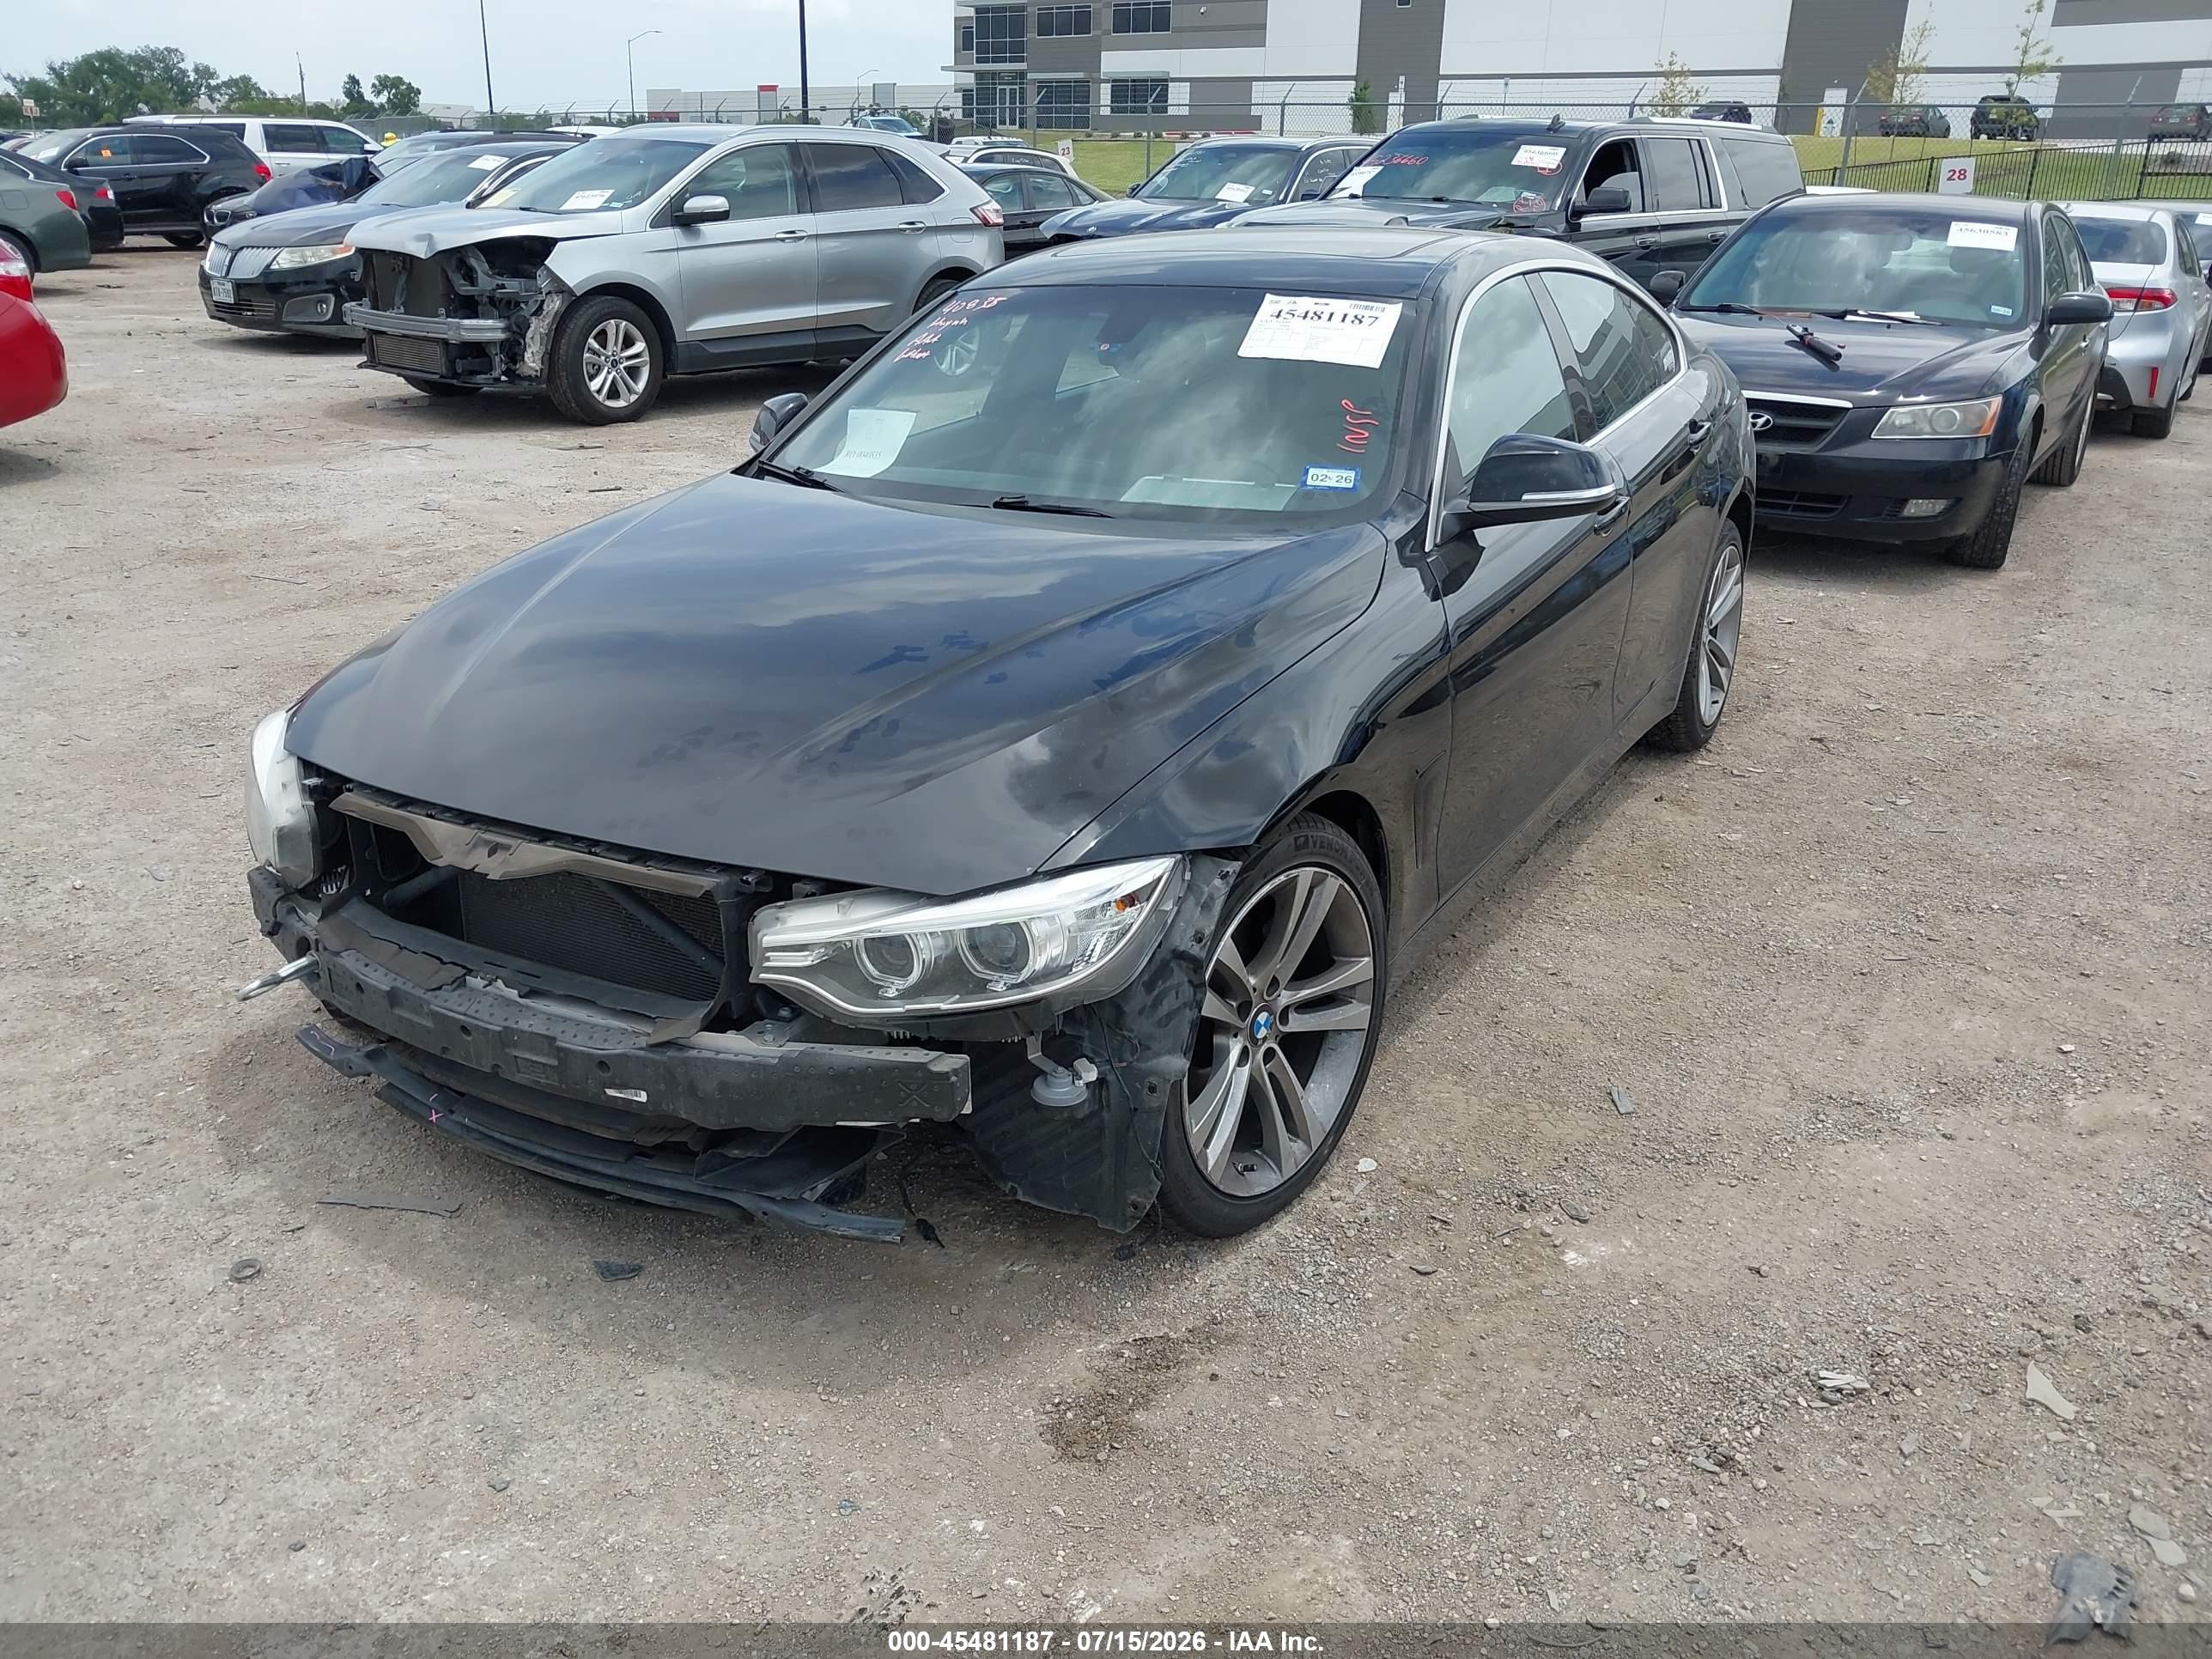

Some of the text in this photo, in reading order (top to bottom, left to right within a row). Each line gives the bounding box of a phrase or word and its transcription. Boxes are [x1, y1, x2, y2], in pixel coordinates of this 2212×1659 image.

[1060, 146, 1071, 156] 23
[1946, 168, 1967, 181] 28
[1269, 307, 1379, 327] 45481187
[1310, 473, 1352, 484] 02 26
